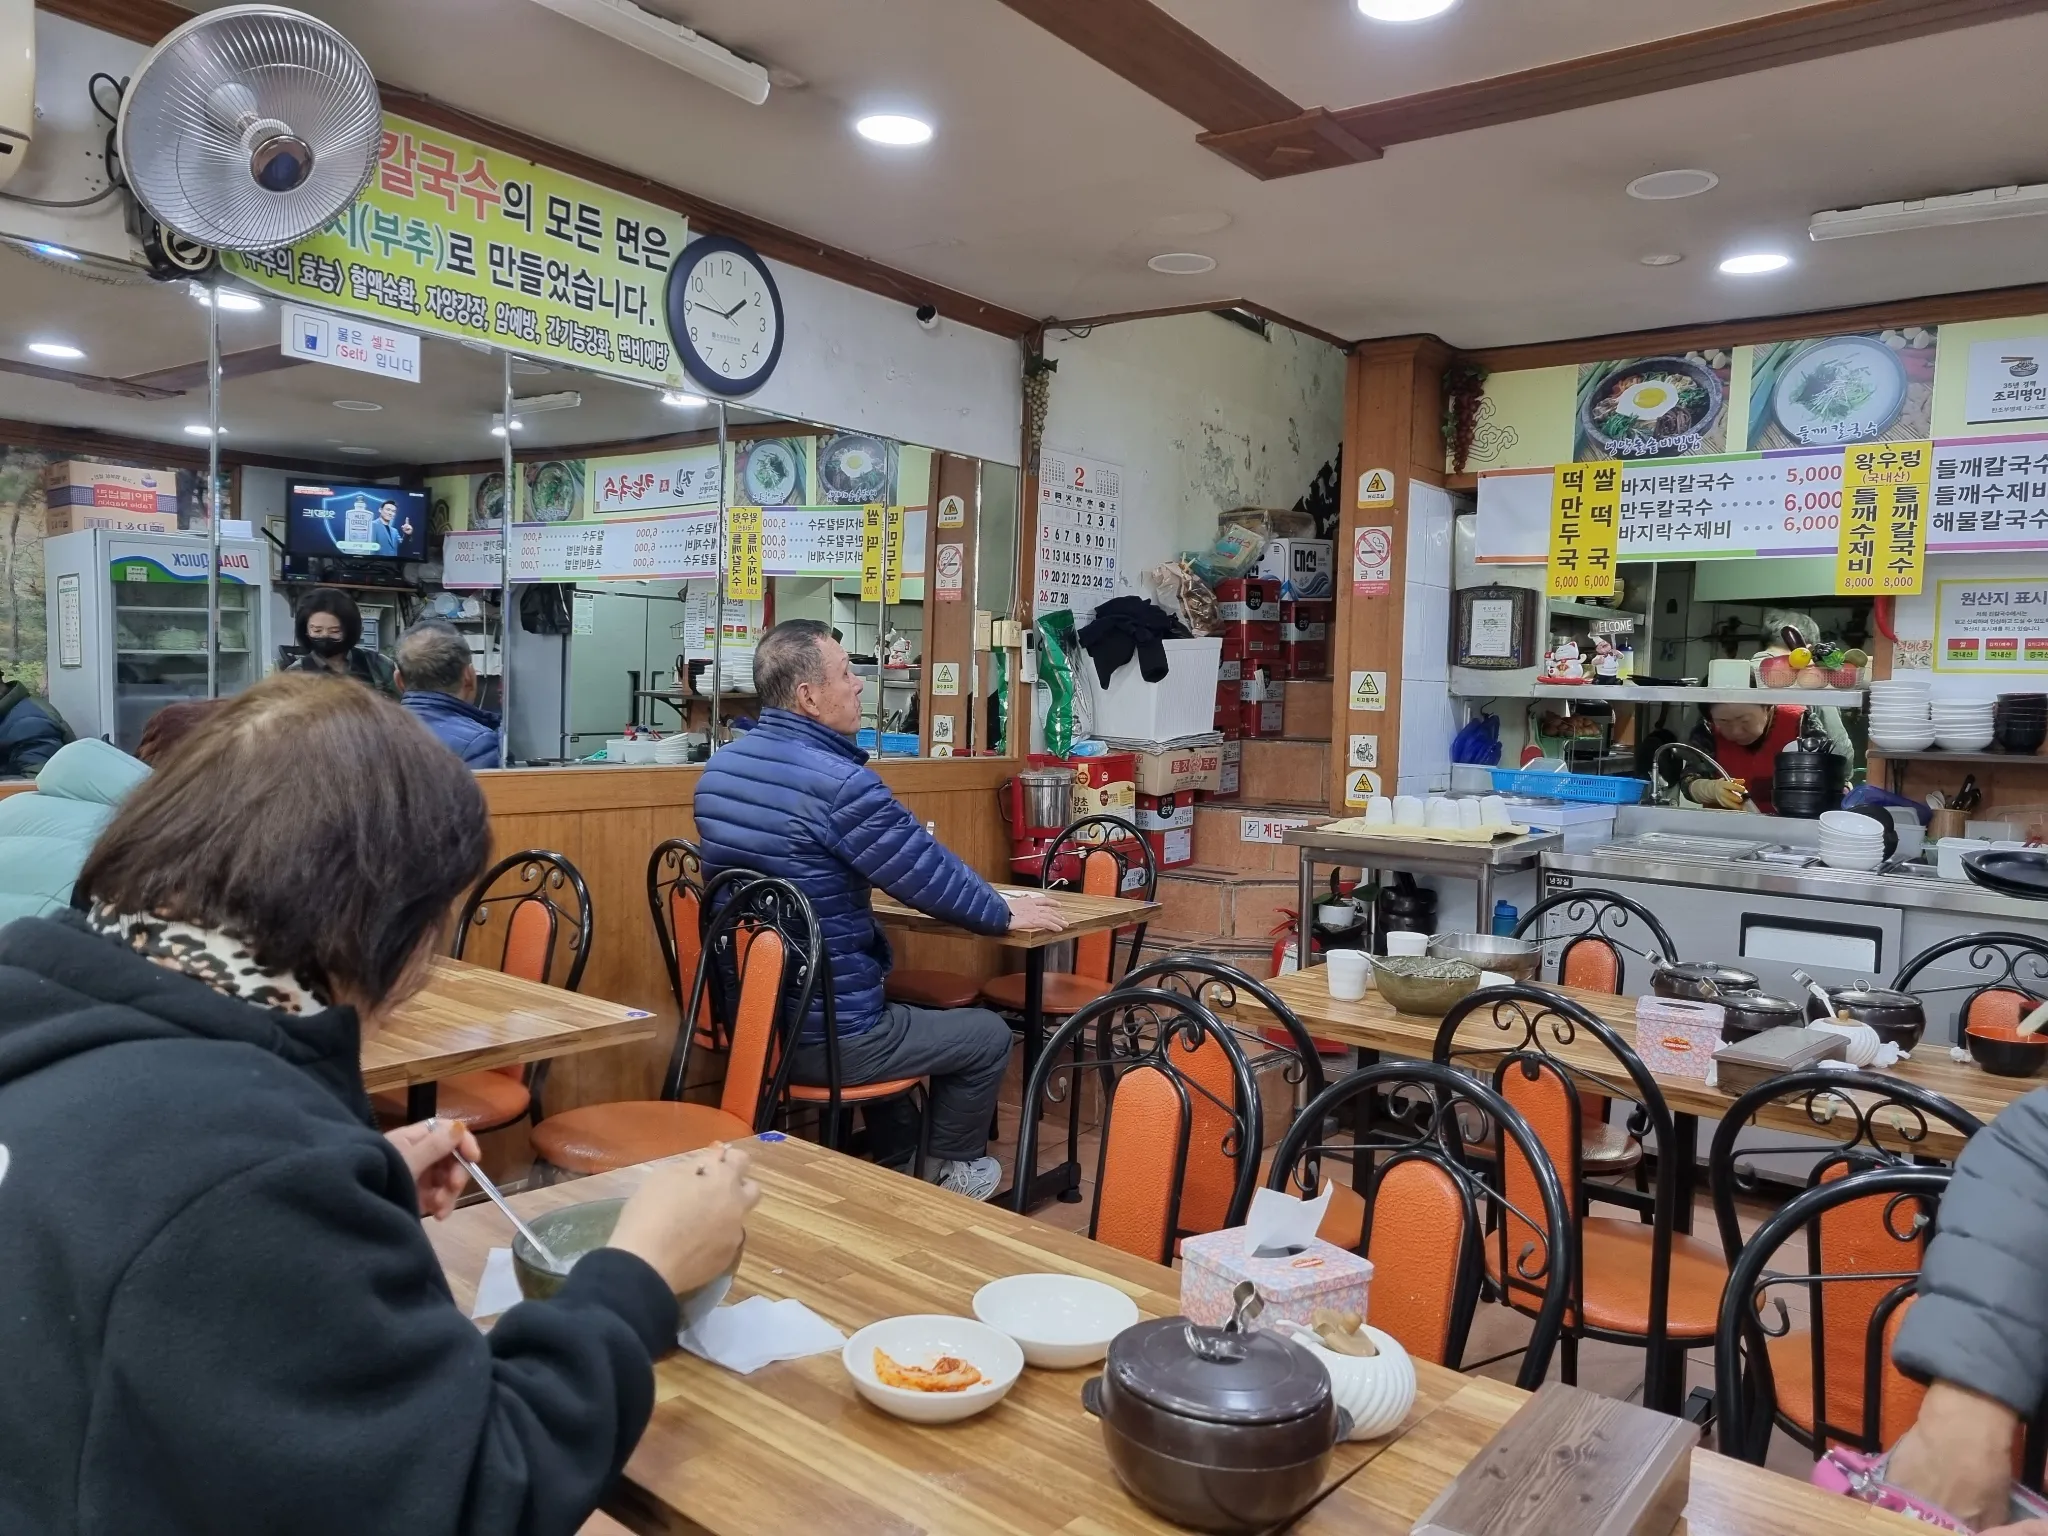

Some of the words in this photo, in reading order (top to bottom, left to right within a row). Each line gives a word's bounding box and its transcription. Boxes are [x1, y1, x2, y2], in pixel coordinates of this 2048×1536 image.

[544, 195, 603, 254] 모든
[616, 217, 670, 273] 면은
[704, 260, 714, 278] 11
[720, 258, 733, 277] 12
[488, 243, 655, 327] 만들었습니다.
[690, 275, 704, 293] 10
[743, 271, 747, 287] 1
[684, 300, 693, 316] 9
[753, 291, 762, 308] 2
[350, 263, 421, 316] 혈액순환,
[425, 285, 489, 331] 자양강장,
[495, 301, 541, 345] 암예방,
[546, 315, 614, 361] 간기능강화,
[618, 333, 669, 371] 변비예방
[759, 317, 767, 333] 3
[337, 327, 362, 346] 물은
[690, 326, 698, 342] 8
[705, 346, 714, 362] 7
[751, 341, 760, 356] 4
[335, 343, 368, 363] (Self)
[375, 352, 414, 374] 입니다
[721, 357, 731, 373] 6
[739, 353, 748, 369] 5
[1992, 387, 2047, 402] 조리명인
[1796, 421, 1879, 445] 들깨칼국수
[1854, 449, 1921, 471] 왕우렁
[1936, 453, 2048, 480] 들깨칼국수
[1074, 466, 1085, 488] 2
[1621, 472, 1735, 496] 바지락칼국수
[1786, 465, 1843, 486] 5,000
[1862, 471, 1911, 484] (국내산)
[1043, 489, 1051, 498] 日
[1065, 494, 1072, 502] 火
[1098, 500, 1106, 509] 金
[1109, 503, 1117, 511] 土
[1934, 481, 2048, 506] 들깨수제비
[1620, 498, 1713, 520] 만두칼국수
[1784, 490, 1843, 513] 6,000
[1077, 511, 1080, 524] 1
[1086, 513, 1092, 525] 2
[1098, 515, 1104, 527] 3
[1109, 517, 1115, 529] 4
[1556, 469, 1583, 571] 떡만두국
[1618, 520, 1732, 542] 바지락수제비
[1783, 514, 1839, 534] 6,000
[1932, 508, 2048, 532] 해물칼국수
[1043, 526, 1049, 539] 5
[1055, 528, 1060, 541] 6
[1064, 529, 1070, 542] 7
[1075, 532, 1081, 544] 8
[1086, 533, 1092, 546] 9
[1095, 535, 1105, 548] 10
[1107, 537, 1116, 549] 11
[1848, 487, 1879, 575] 들깨수제비
[1887, 486, 1920, 574] 들깨칼국수
[1041, 547, 1050, 561] 12
[1052, 549, 1061, 562] 13
[1062, 550, 1070, 563] 14
[1072, 552, 1081, 565] 15
[1083, 554, 1092, 566] 16
[1094, 555, 1103, 568] 17
[1105, 557, 1115, 569] 18
[1294, 549, 1317, 573] 대선
[1041, 569, 1049, 581] 19
[1051, 570, 1060, 583] 20
[1061, 571, 1070, 584] 21
[1071, 572, 1080, 586] 22
[1081, 574, 1092, 587] 23
[1093, 575, 1103, 588] 24
[1104, 577, 1114, 589] 25
[1555, 575, 1579, 590] 6,000
[1584, 574, 1610, 589] 6,000
[1845, 577, 1874, 590] 8,000
[1884, 576, 1914, 588] 8,000
[1039, 589, 1049, 603] 26
[1050, 591, 1059, 604] 27
[1060, 592, 1069, 605] 28
[1960, 591, 2009, 606] 원산지
[2014, 590, 2048, 605] 표시
[1591, 619, 1632, 633] WELCOME
[1203, 758, 1218, 770] 국수
[1549, 876, 1570, 886] 냉장실
